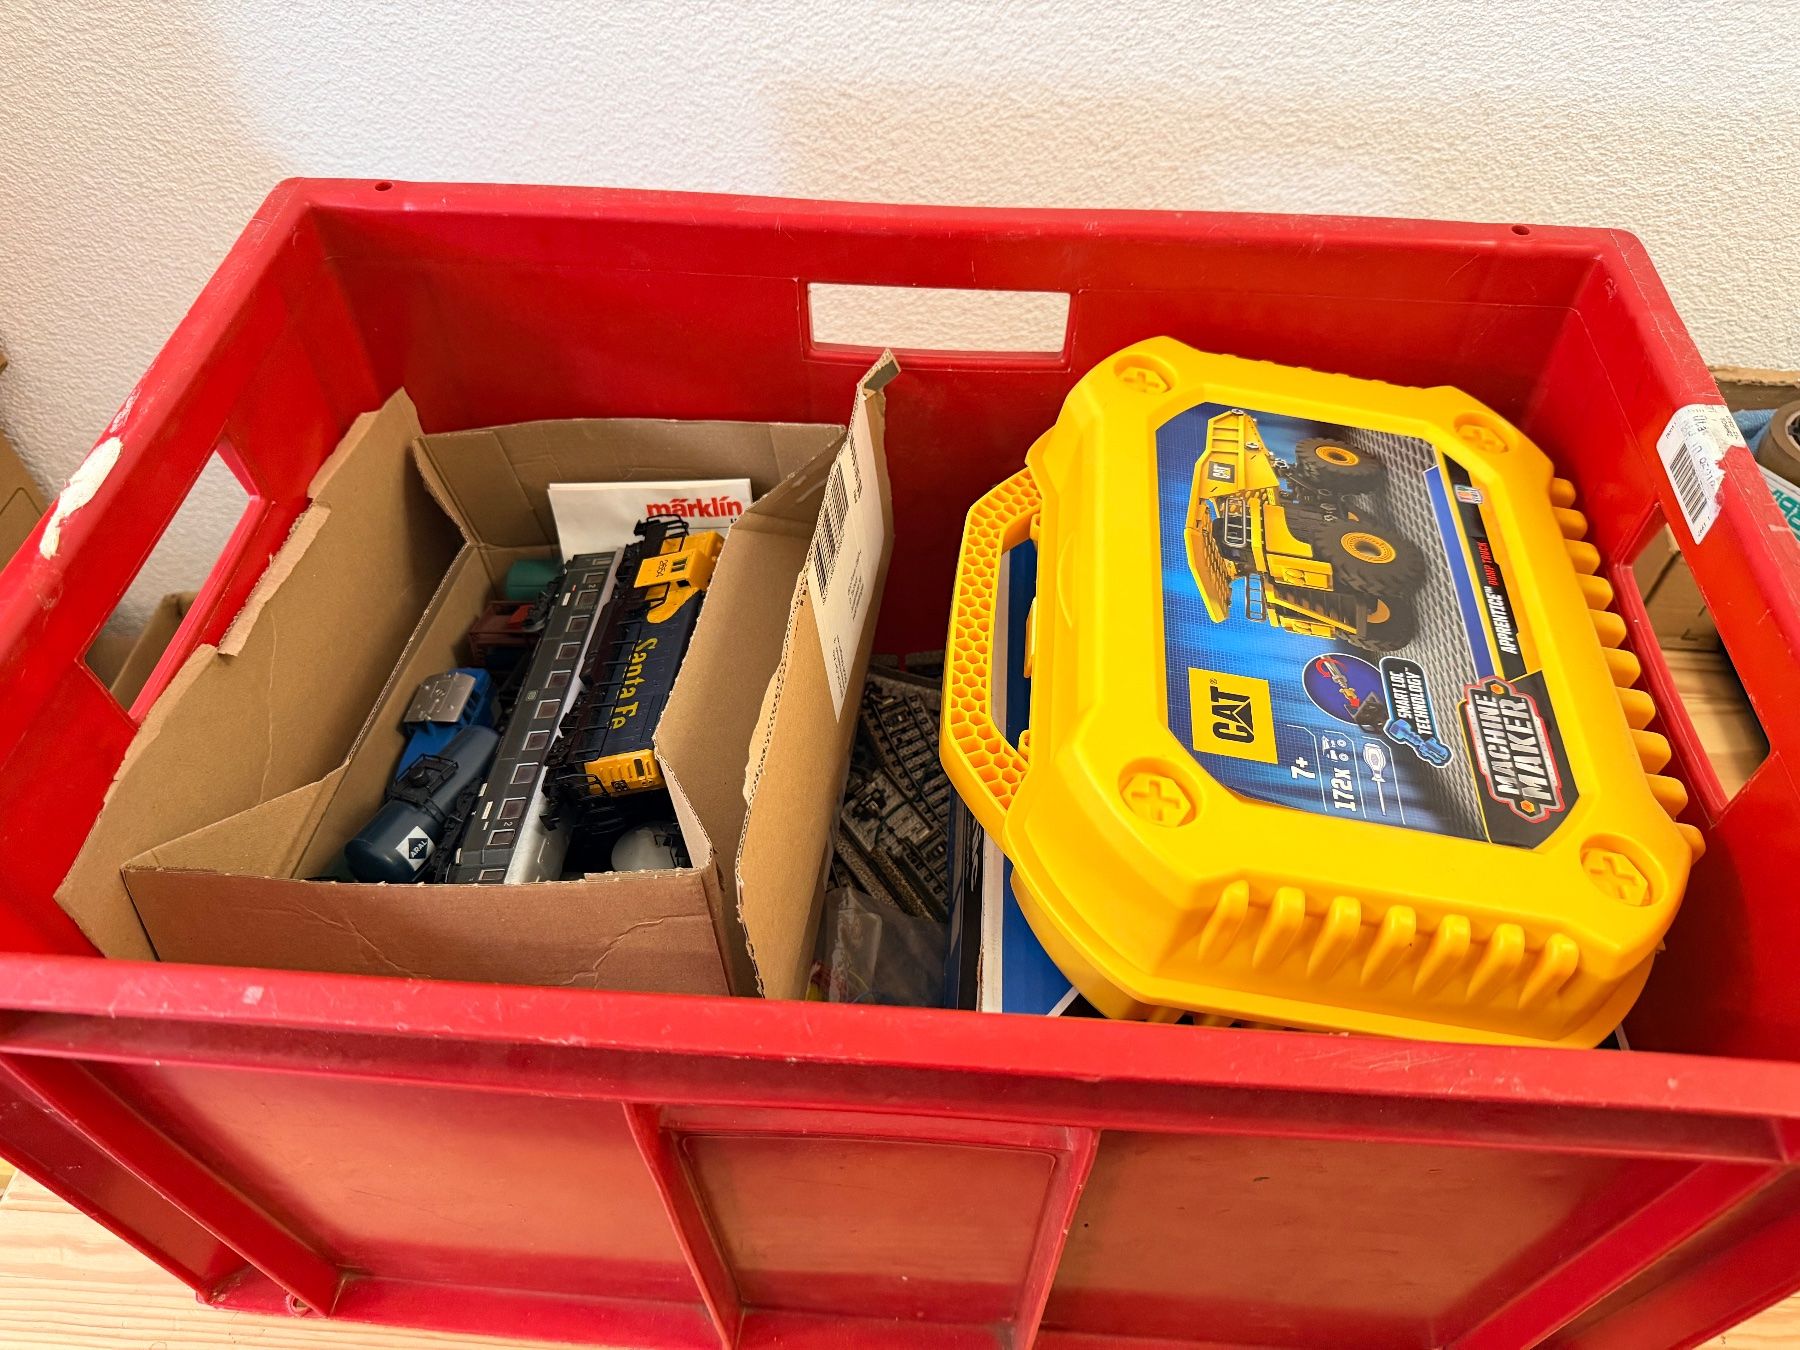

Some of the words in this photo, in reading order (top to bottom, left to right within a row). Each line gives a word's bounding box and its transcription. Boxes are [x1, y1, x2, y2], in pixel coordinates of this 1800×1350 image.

[1477, 541, 1493, 562] TRUCK
[1484, 564, 1499, 586] DUMP
[617, 637, 658, 699] Santa
[1389, 670, 1406, 688] LOC
[608, 701, 639, 730] Fe
[1392, 687, 1414, 719] SMART
[1474, 694, 1520, 795] MACHINE
[1498, 698, 1553, 800] MAKER
[1291, 756, 1316, 779] 7+
[411, 840, 427, 858] ARAL
